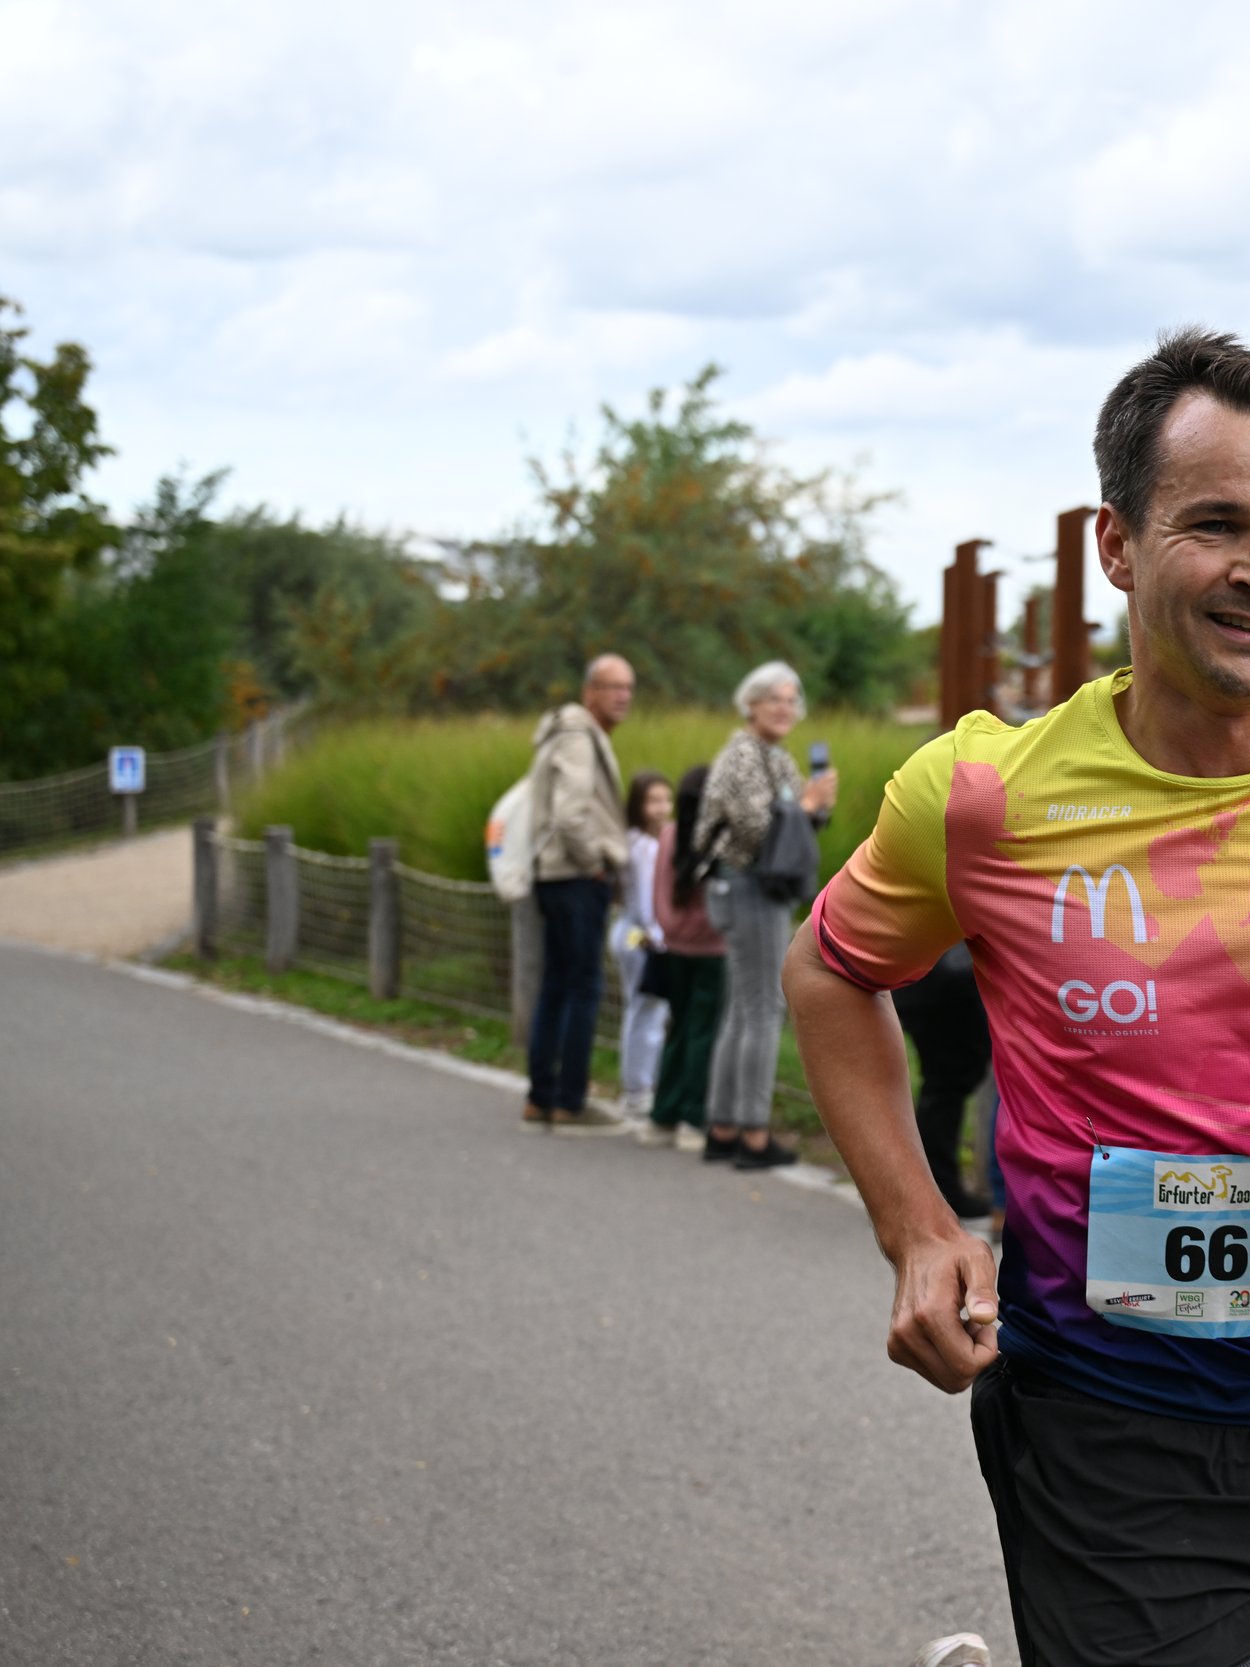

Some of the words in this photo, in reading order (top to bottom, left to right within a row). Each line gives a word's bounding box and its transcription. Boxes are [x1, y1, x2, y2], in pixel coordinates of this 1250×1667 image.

[1046, 803, 1132, 822] BIORACER
[1057, 979, 1159, 1023] GO!
[1110, 1029, 1160, 1037] LOGISTICS
[1158, 1184, 1214, 1205] Erfurter
[1179, 1294, 1200, 1302] WBG
